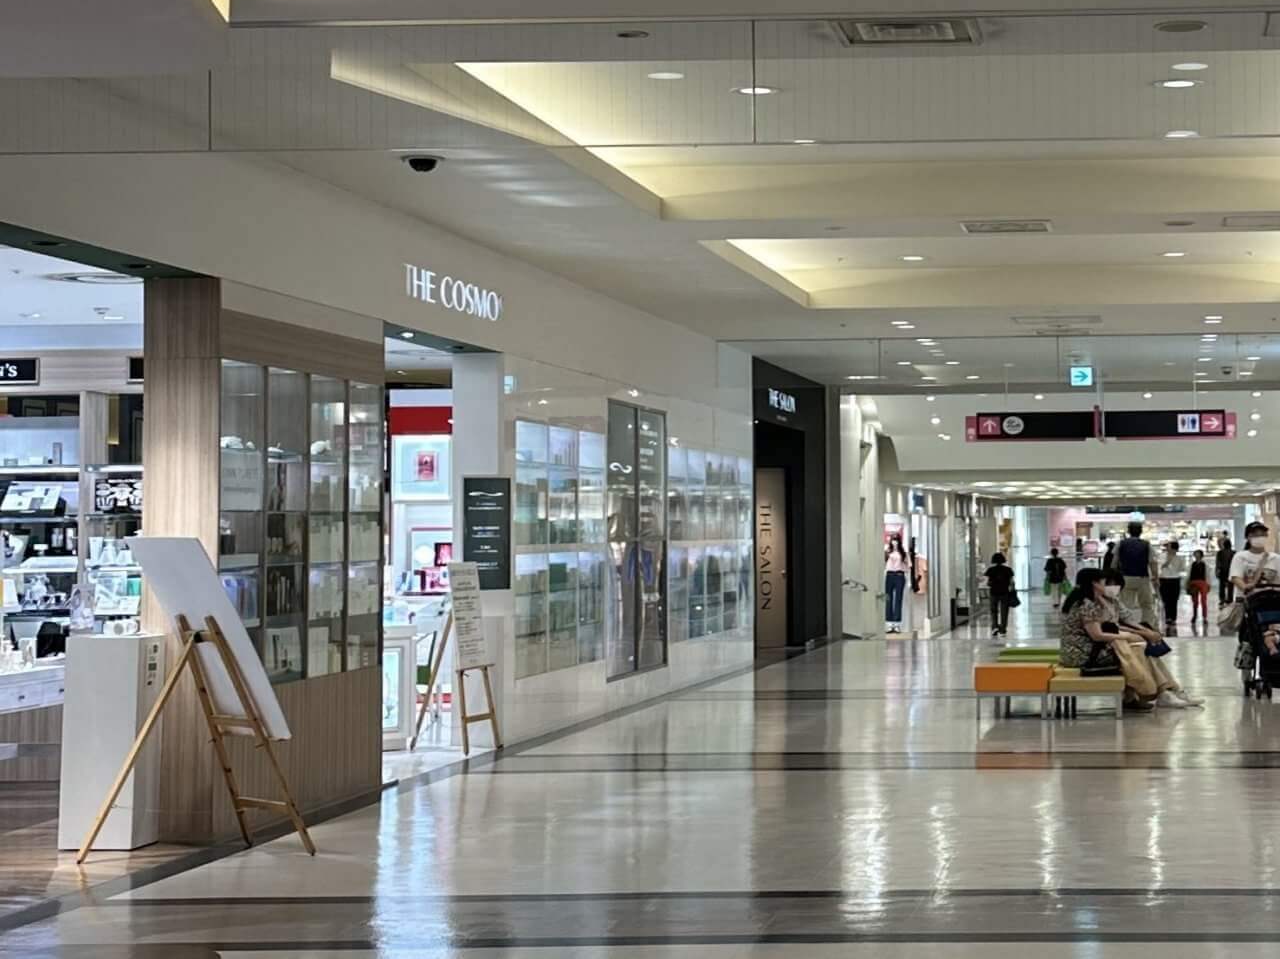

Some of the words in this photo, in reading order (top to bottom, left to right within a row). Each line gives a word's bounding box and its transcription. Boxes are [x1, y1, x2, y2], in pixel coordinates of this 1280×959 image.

[403, 263, 436, 304] THE
[760, 504, 772, 538] THE
[760, 545, 773, 610] SALON
